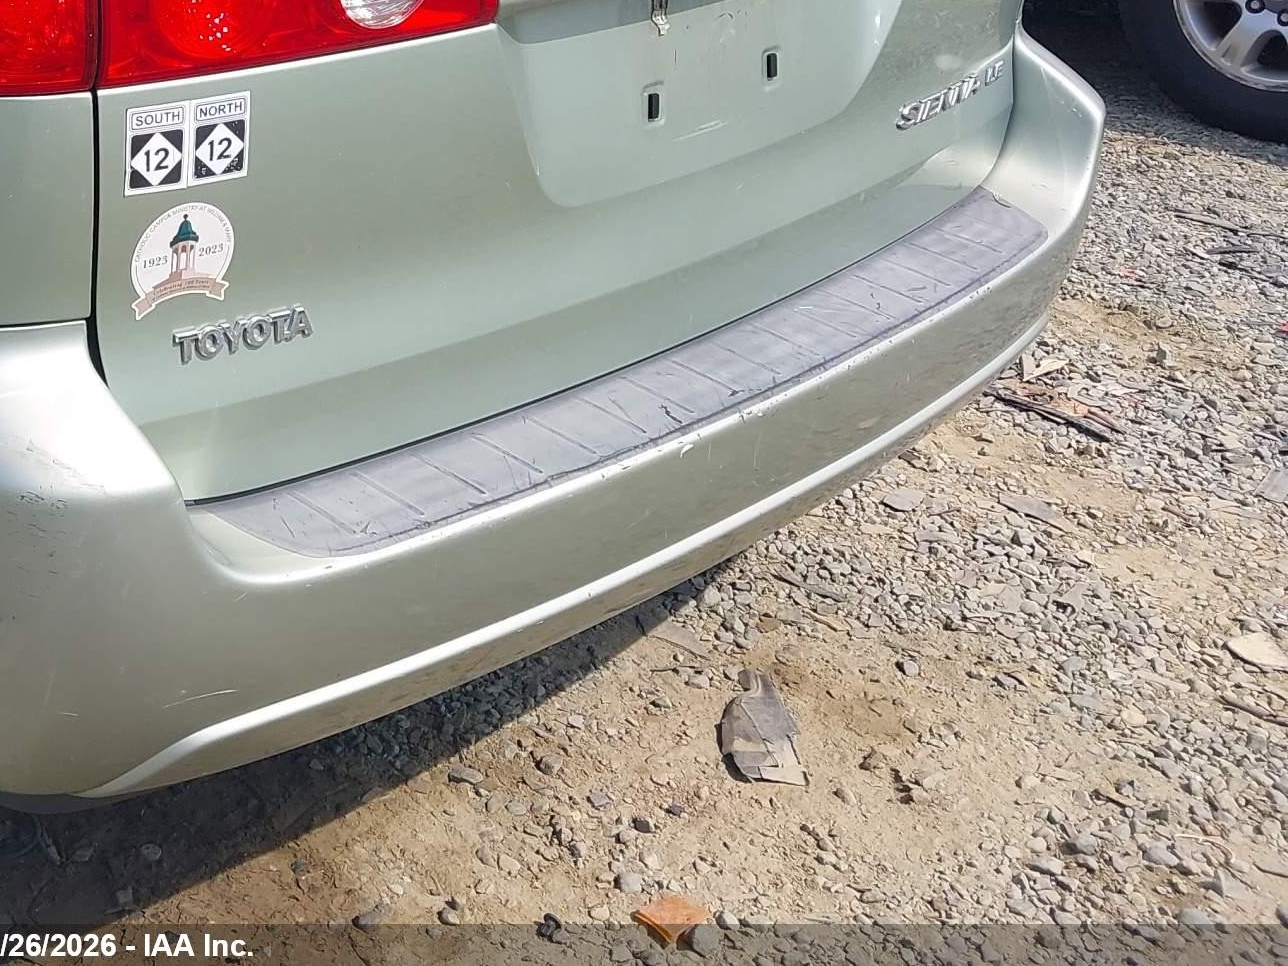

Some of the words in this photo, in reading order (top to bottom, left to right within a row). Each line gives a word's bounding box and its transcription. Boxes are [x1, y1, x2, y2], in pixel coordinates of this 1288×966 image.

[199, 101, 243, 118] NORTH
[135, 111, 181, 127] SOUTH
[207, 137, 233, 161] 12
[144, 147, 170, 172] 12
[198, 243, 224, 257] 2023
[142, 255, 168, 269] 1923
[172, 304, 313, 366] TOYOTA
